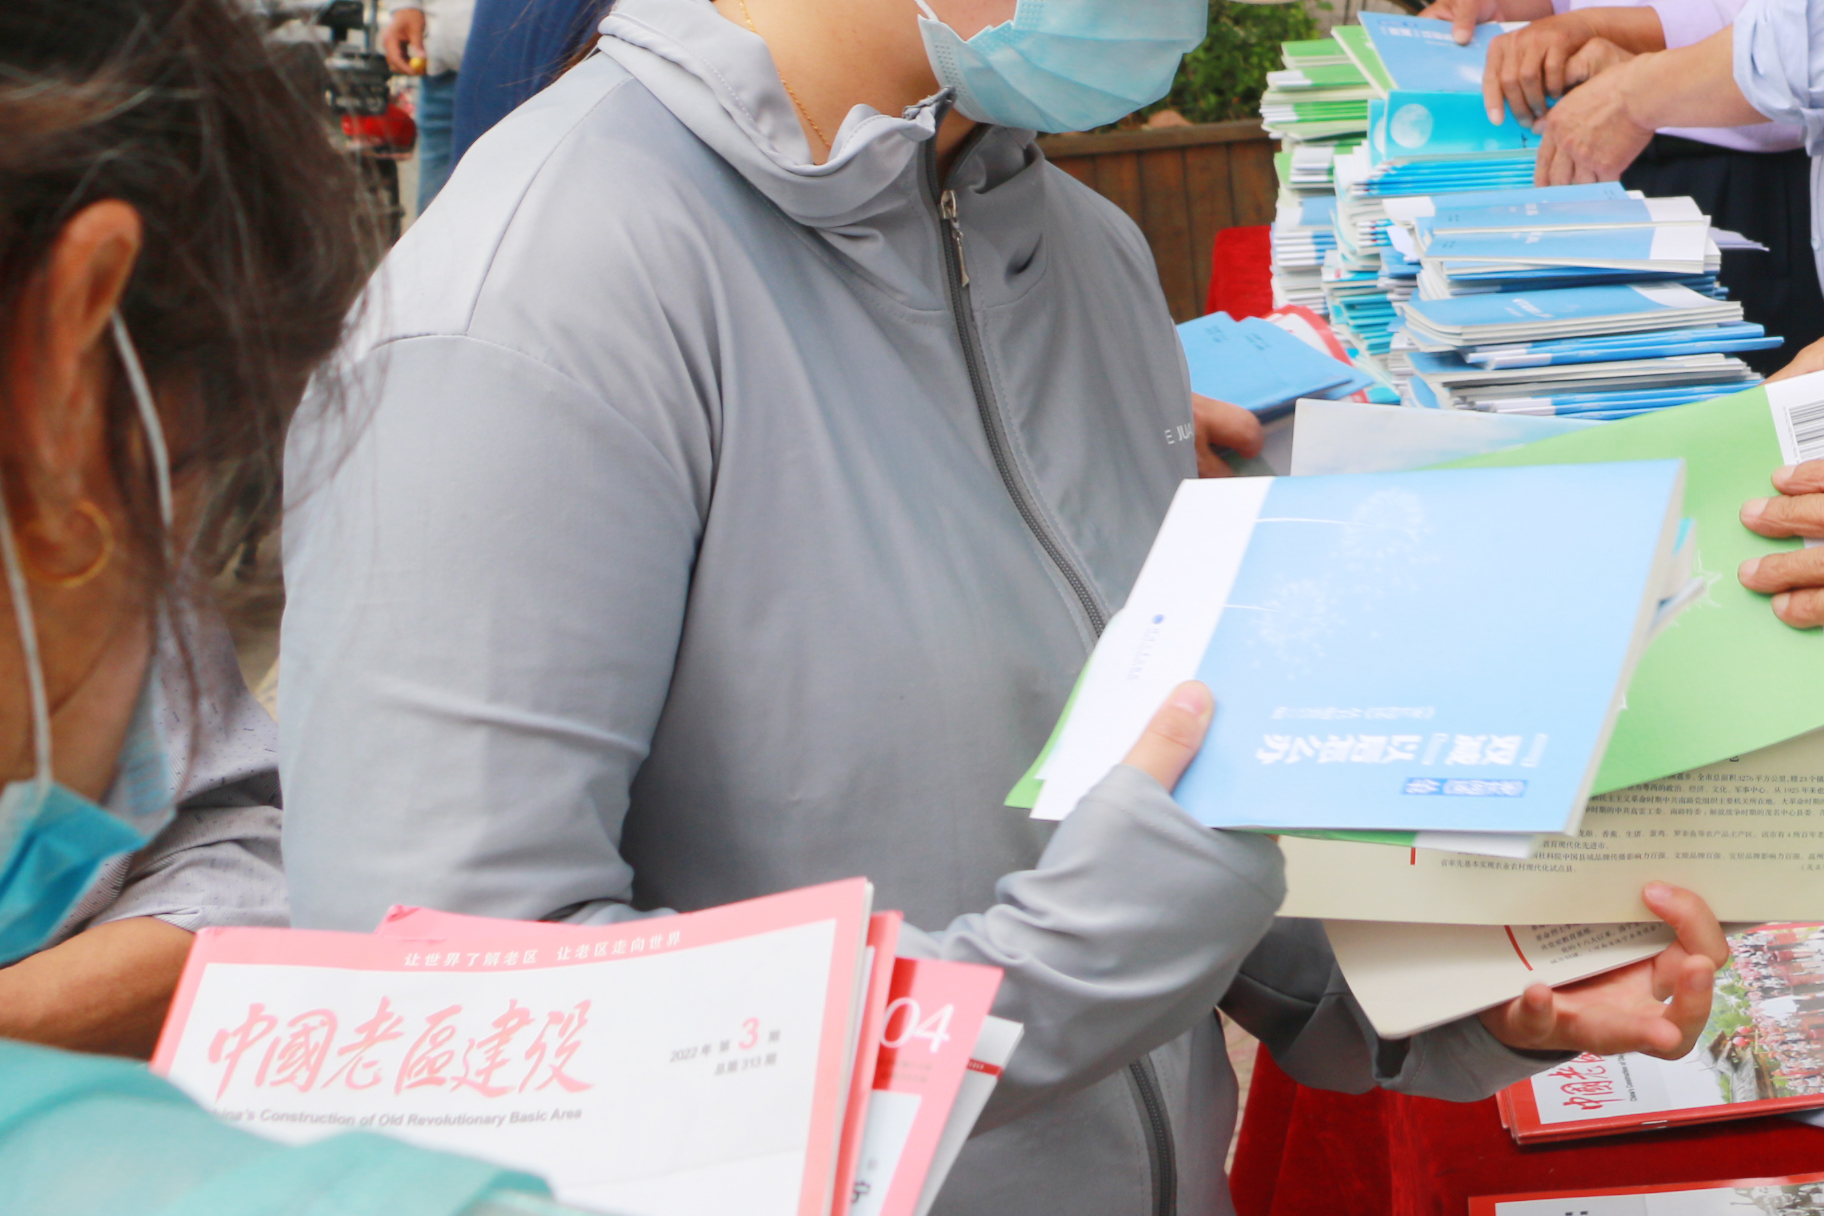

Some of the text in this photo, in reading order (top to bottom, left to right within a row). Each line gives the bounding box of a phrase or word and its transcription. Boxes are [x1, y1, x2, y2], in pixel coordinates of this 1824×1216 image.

[404, 930, 683, 968] 让世界了解老区 让老区走向世界
[879, 996, 956, 1054] 04
[260, 1107, 357, 1127] Construction
[359, 1111, 376, 1126] of
[378, 1111, 404, 1126] Old
[406, 1111, 506, 1129] Revolutionary
[509, 1109, 548, 1125] Basic
[550, 1106, 583, 1122] Area
